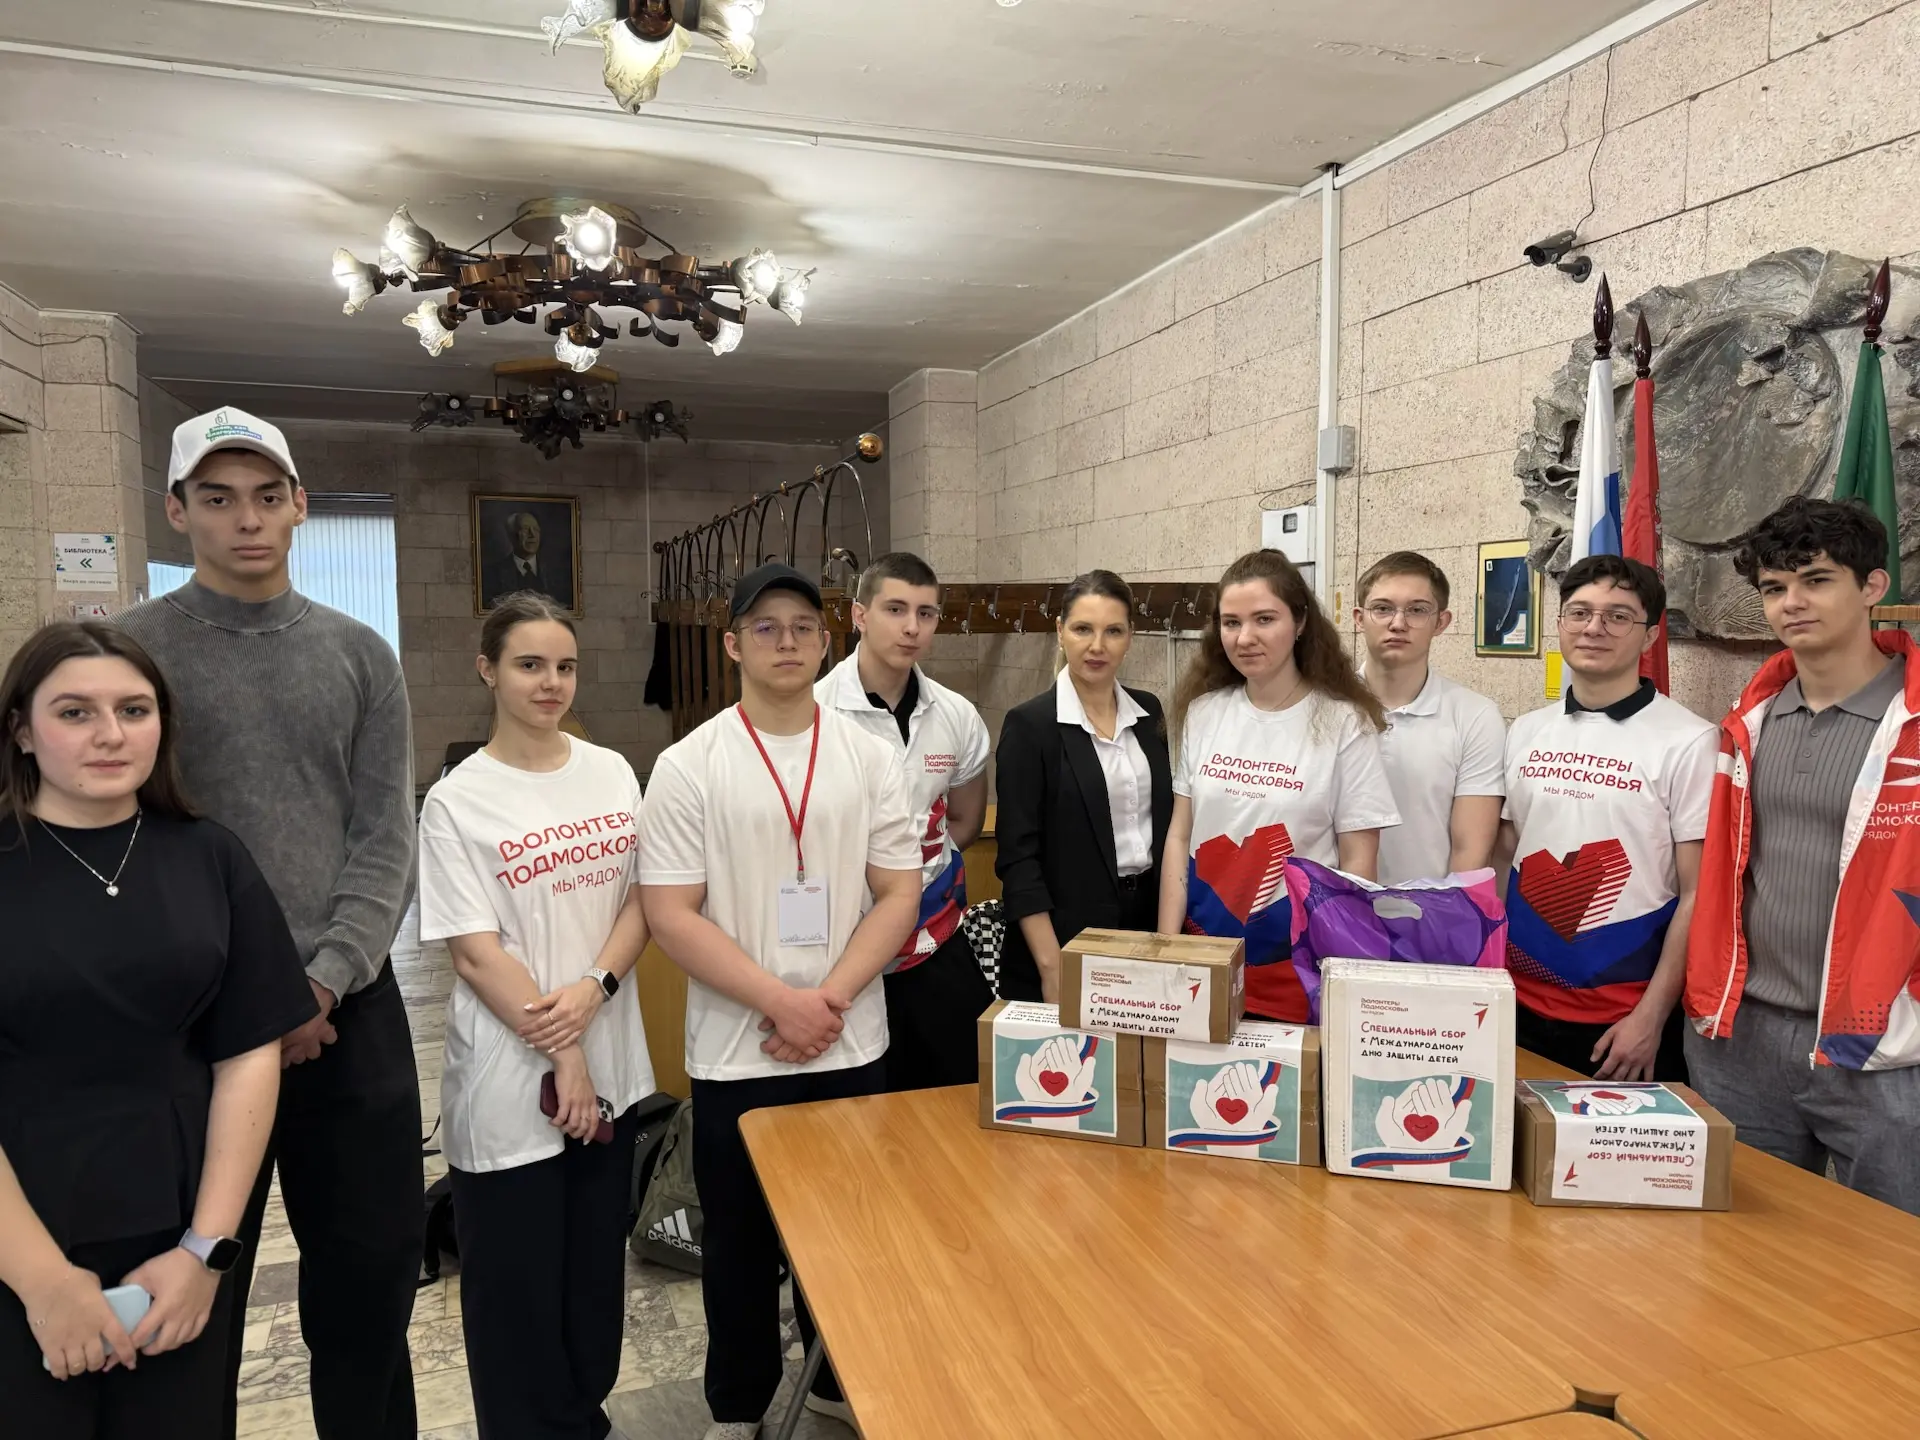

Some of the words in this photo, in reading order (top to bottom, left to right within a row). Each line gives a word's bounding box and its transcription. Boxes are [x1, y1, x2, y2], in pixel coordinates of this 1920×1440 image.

[1211, 753, 1297, 775] ВОЛОНТЕРЫ
[1528, 750, 1633, 773] ВОЛОНТЕРЫ
[1199, 764, 1304, 791] ПОДМОСКОВЬЯ
[1517, 765, 1642, 793] ПОДМОСКОВЬЯ
[1224, 787, 1240, 797] МЫ
[1242, 791, 1266, 799] РЯДОМ
[1543, 786, 1560, 795] МЫ
[1562, 788, 1595, 800] РЯДОМ
[1873, 801, 1920, 813] ОНТЕР
[496, 834, 637, 889] ПОДМОСКОВ
[552, 878, 576, 896] МЫ
[577, 864, 624, 889] РЯДОМ
[1090, 992, 1156, 1009] СПЕЦИАЛЬНЫЙ
[1159, 1003, 1182, 1011] СБОР
[1097, 1007, 1180, 1024] МЕЖДУНАРОДНОМУ
[1112, 1021, 1145, 1031] ЗАЩИТЫ
[1148, 1026, 1175, 1034] ДЕТЕЙ
[1361, 1021, 1437, 1037] СПЕЦИАЛЬНЫЙ
[1441, 1030, 1466, 1038] СБОР
[1370, 1036, 1464, 1051] МЕЖДУНАРОДНОМУ
[1386, 1051, 1424, 1061] ЗАЩИТЫ
[1428, 1055, 1459, 1064] ДЕТЕЙ
[1595, 1125, 1626, 1133] ДЕТЕЙ
[1630, 1127, 1670, 1136] ЗАЩИТЫ
[1590, 1138, 1685, 1151] МЕЖДУНАРОДНОМУ
[1587, 1152, 1612, 1160] СБОР
[1616, 1152, 1694, 1167] СПЕЦИАЛЬНЫЙ
[648, 1229, 702, 1256] adidas
